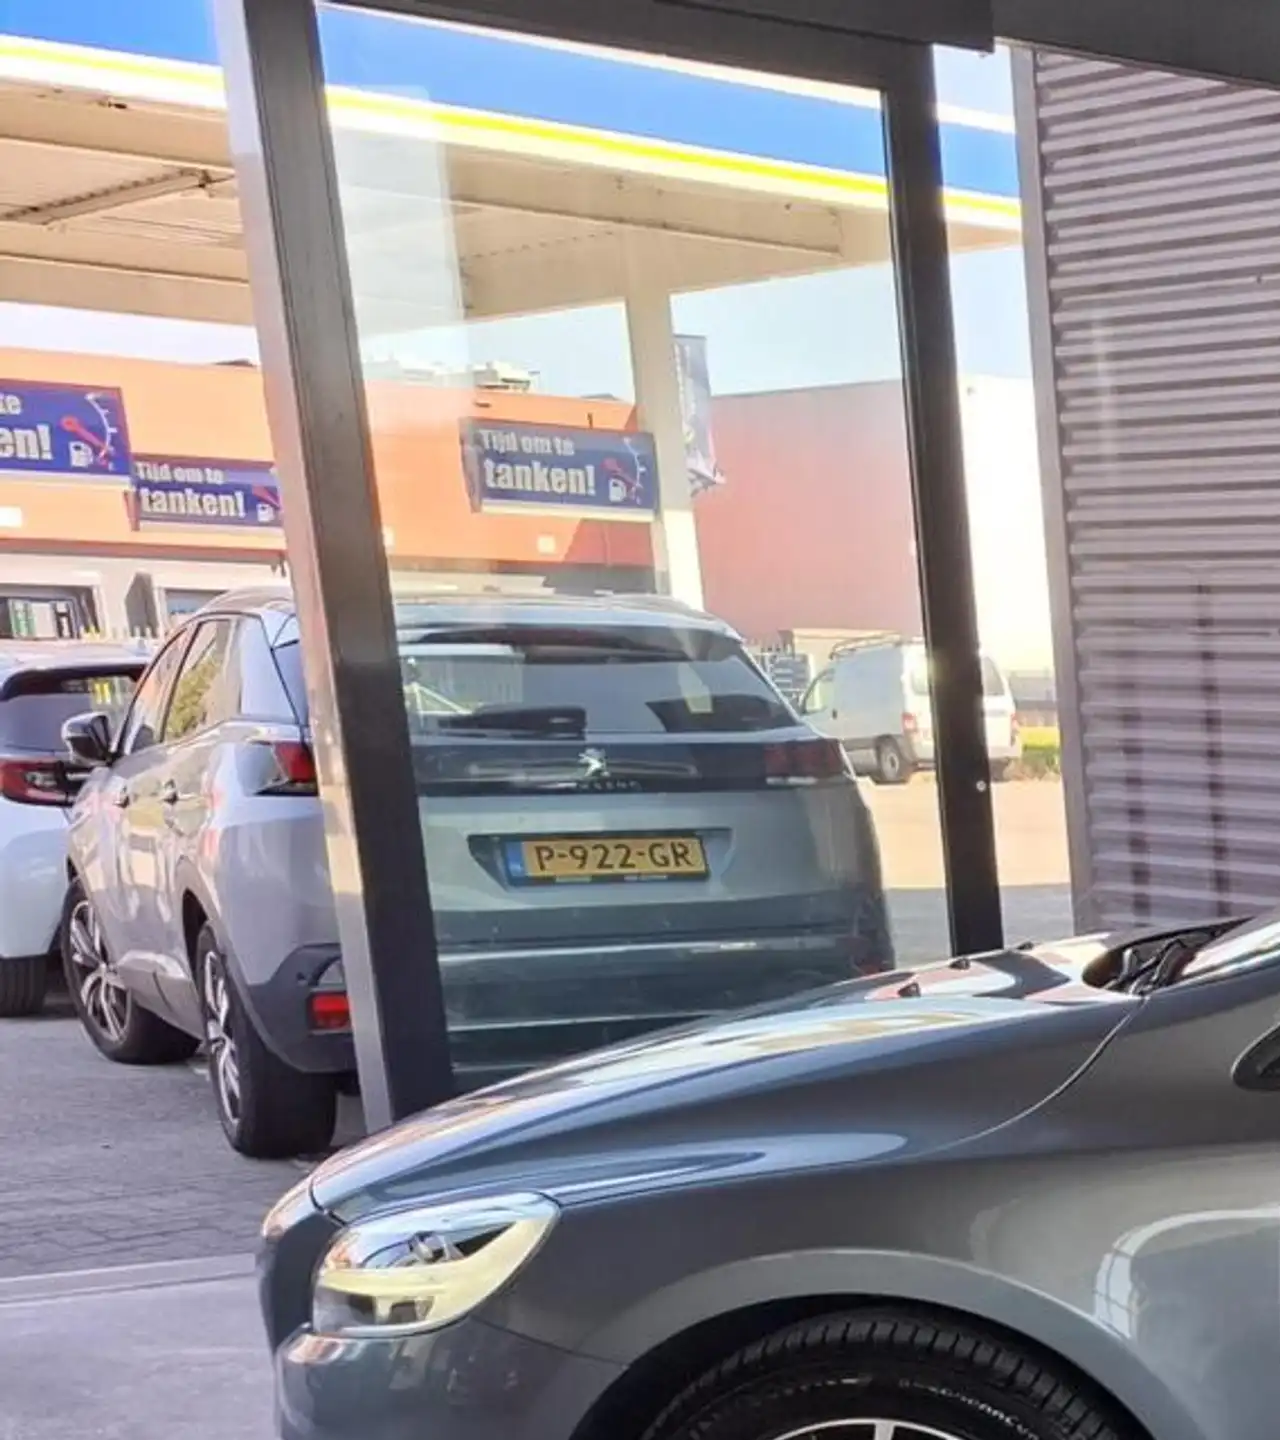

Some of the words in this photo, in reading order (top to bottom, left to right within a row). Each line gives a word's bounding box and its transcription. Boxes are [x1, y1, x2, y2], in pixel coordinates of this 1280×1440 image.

[520, 435, 553, 454] om
[173, 467, 203, 483] om
[484, 458, 596, 496] tanken!
[139, 487, 246, 518] tanken!
[534, 841, 694, 872] P-922-GR
